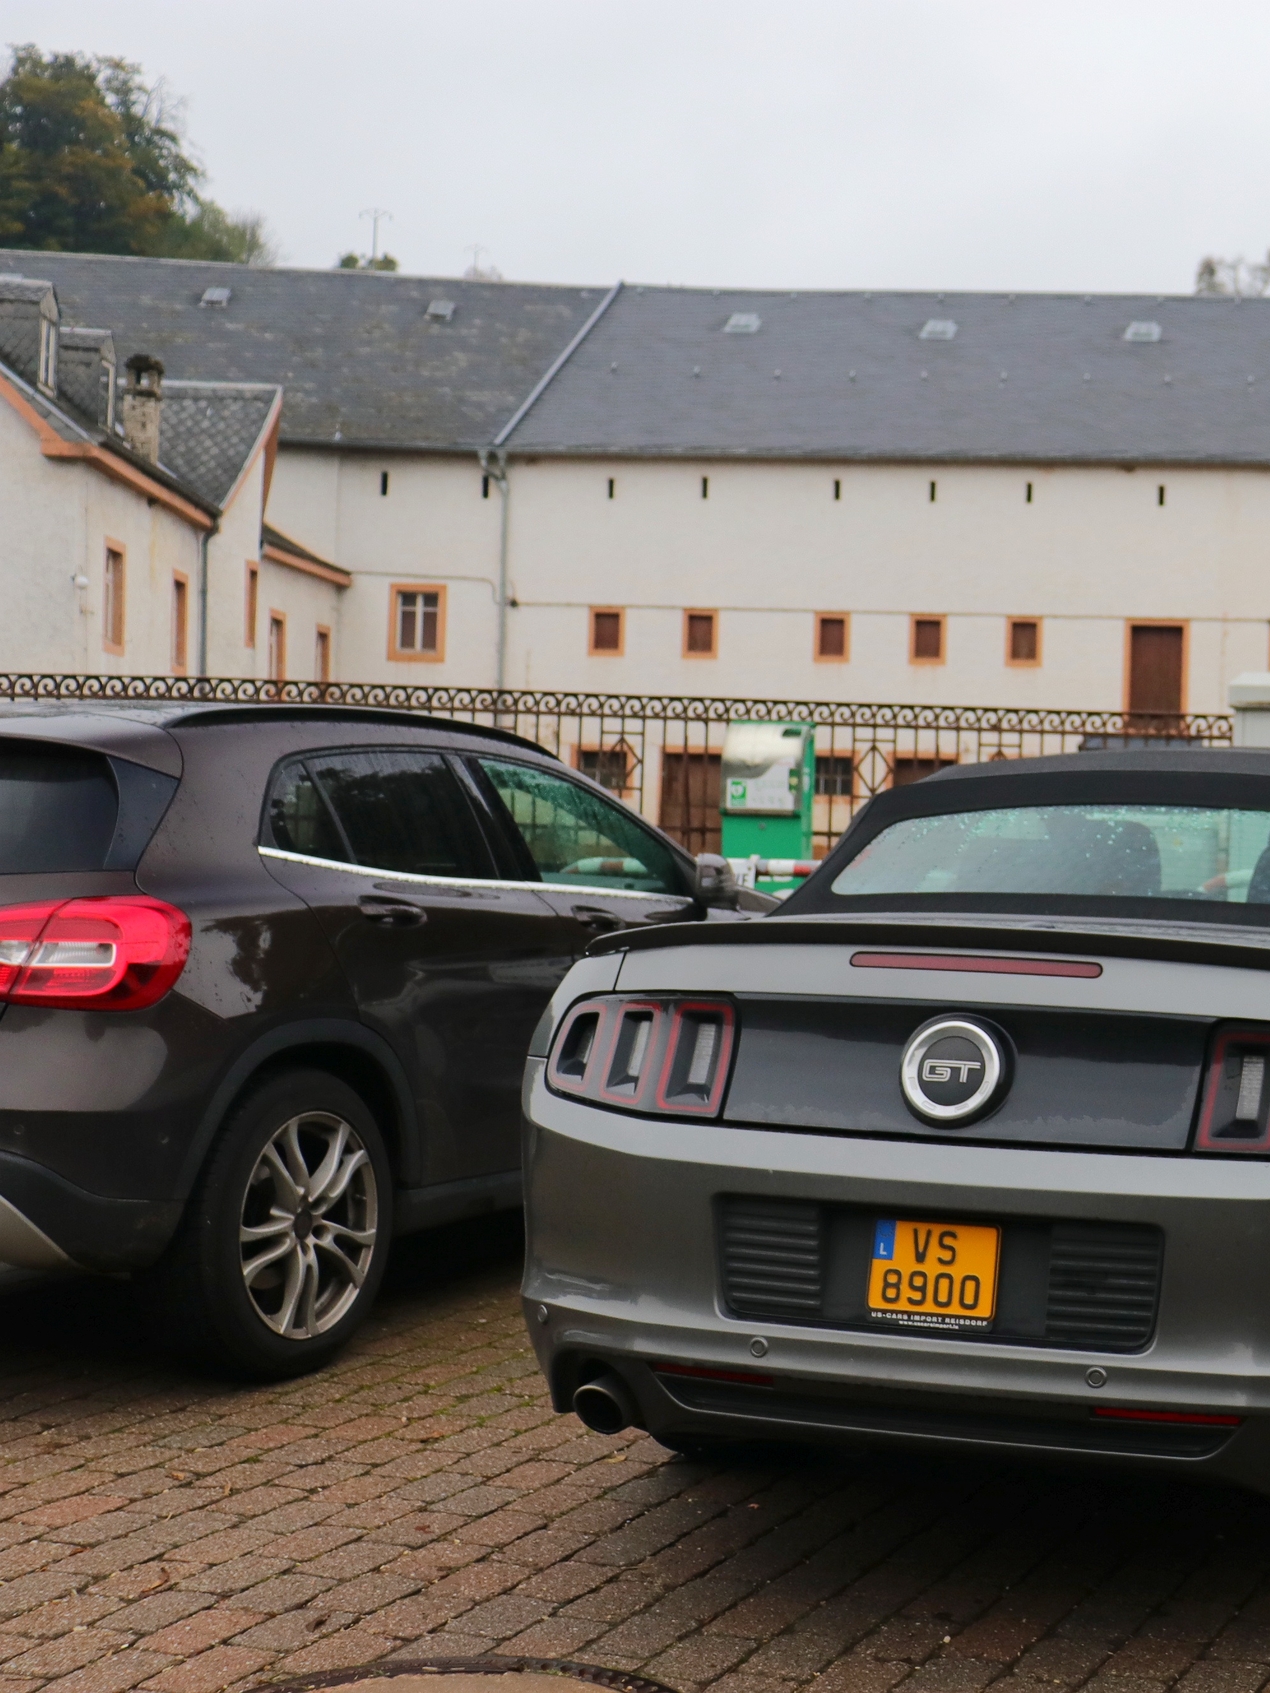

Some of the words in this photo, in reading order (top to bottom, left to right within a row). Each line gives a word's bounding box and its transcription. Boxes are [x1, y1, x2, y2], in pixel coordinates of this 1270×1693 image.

[922, 1059, 981, 1083] GT
[879, 1242, 888, 1255] L
[913, 1228, 958, 1266] VS
[881, 1268, 981, 1310] 8900
[871, 1311, 908, 1320] US-CARS
[910, 1315, 942, 1323] IMPORT
[945, 1318, 988, 1327] REISDORF
